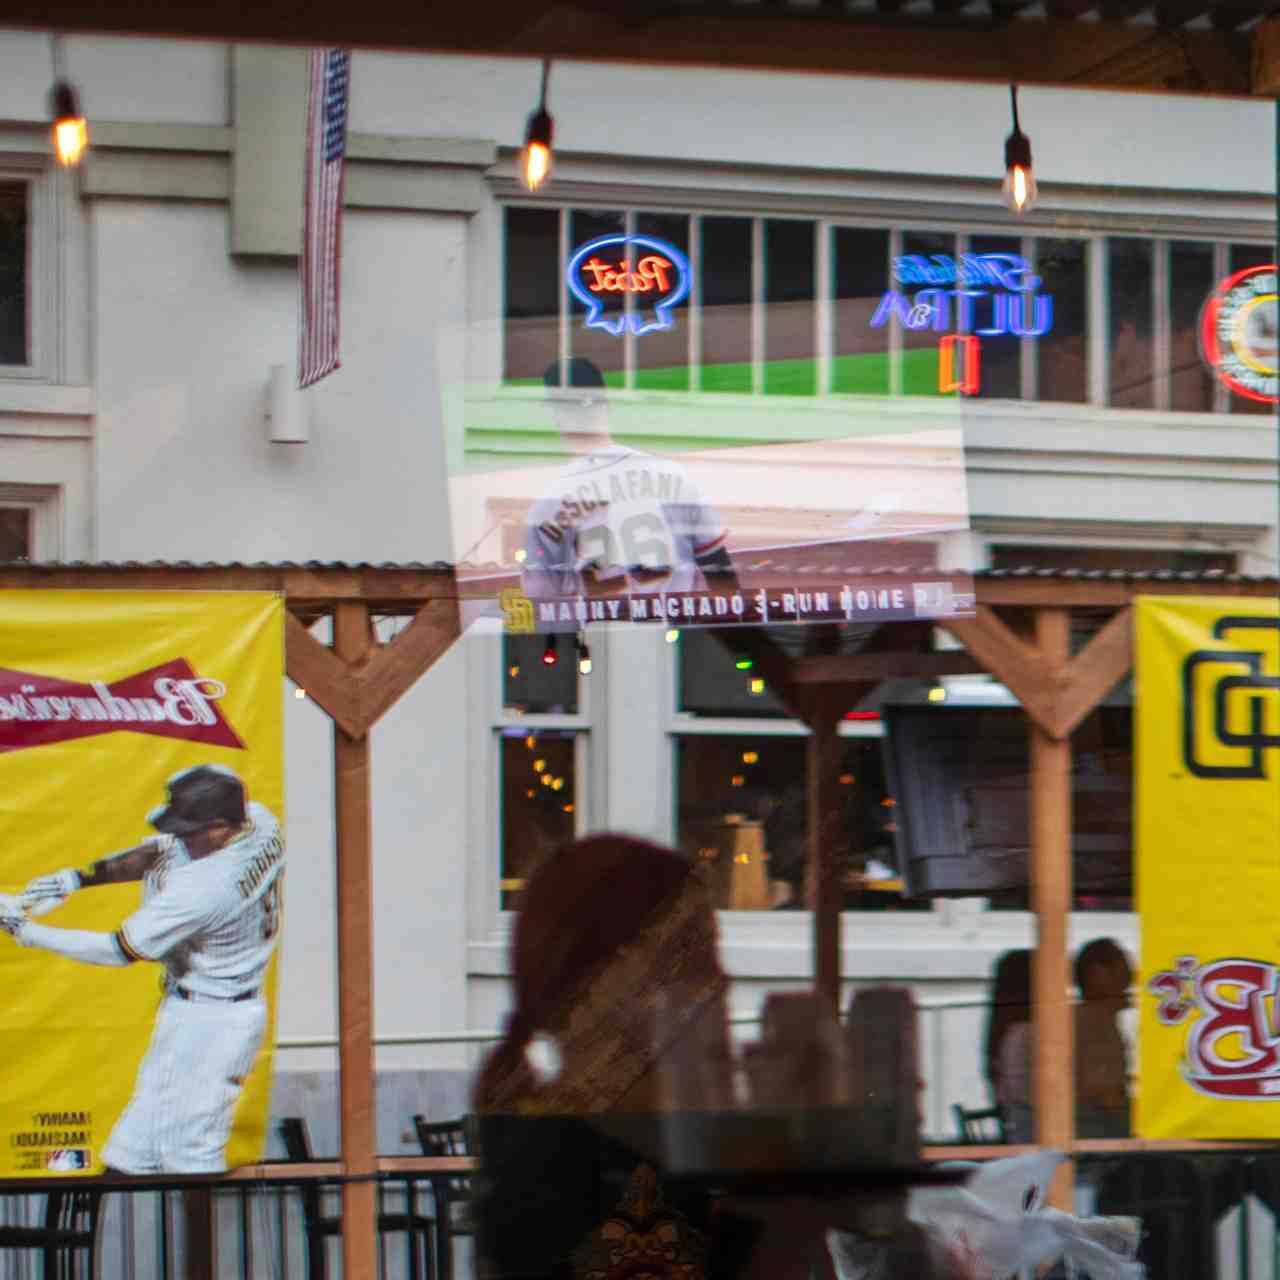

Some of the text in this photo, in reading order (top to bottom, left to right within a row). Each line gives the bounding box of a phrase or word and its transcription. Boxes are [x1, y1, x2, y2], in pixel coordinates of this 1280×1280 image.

[539, 600, 621, 625] MANNY
[630, 595, 744, 619] MACHADO
[754, 590, 829, 615] 3-RUN
